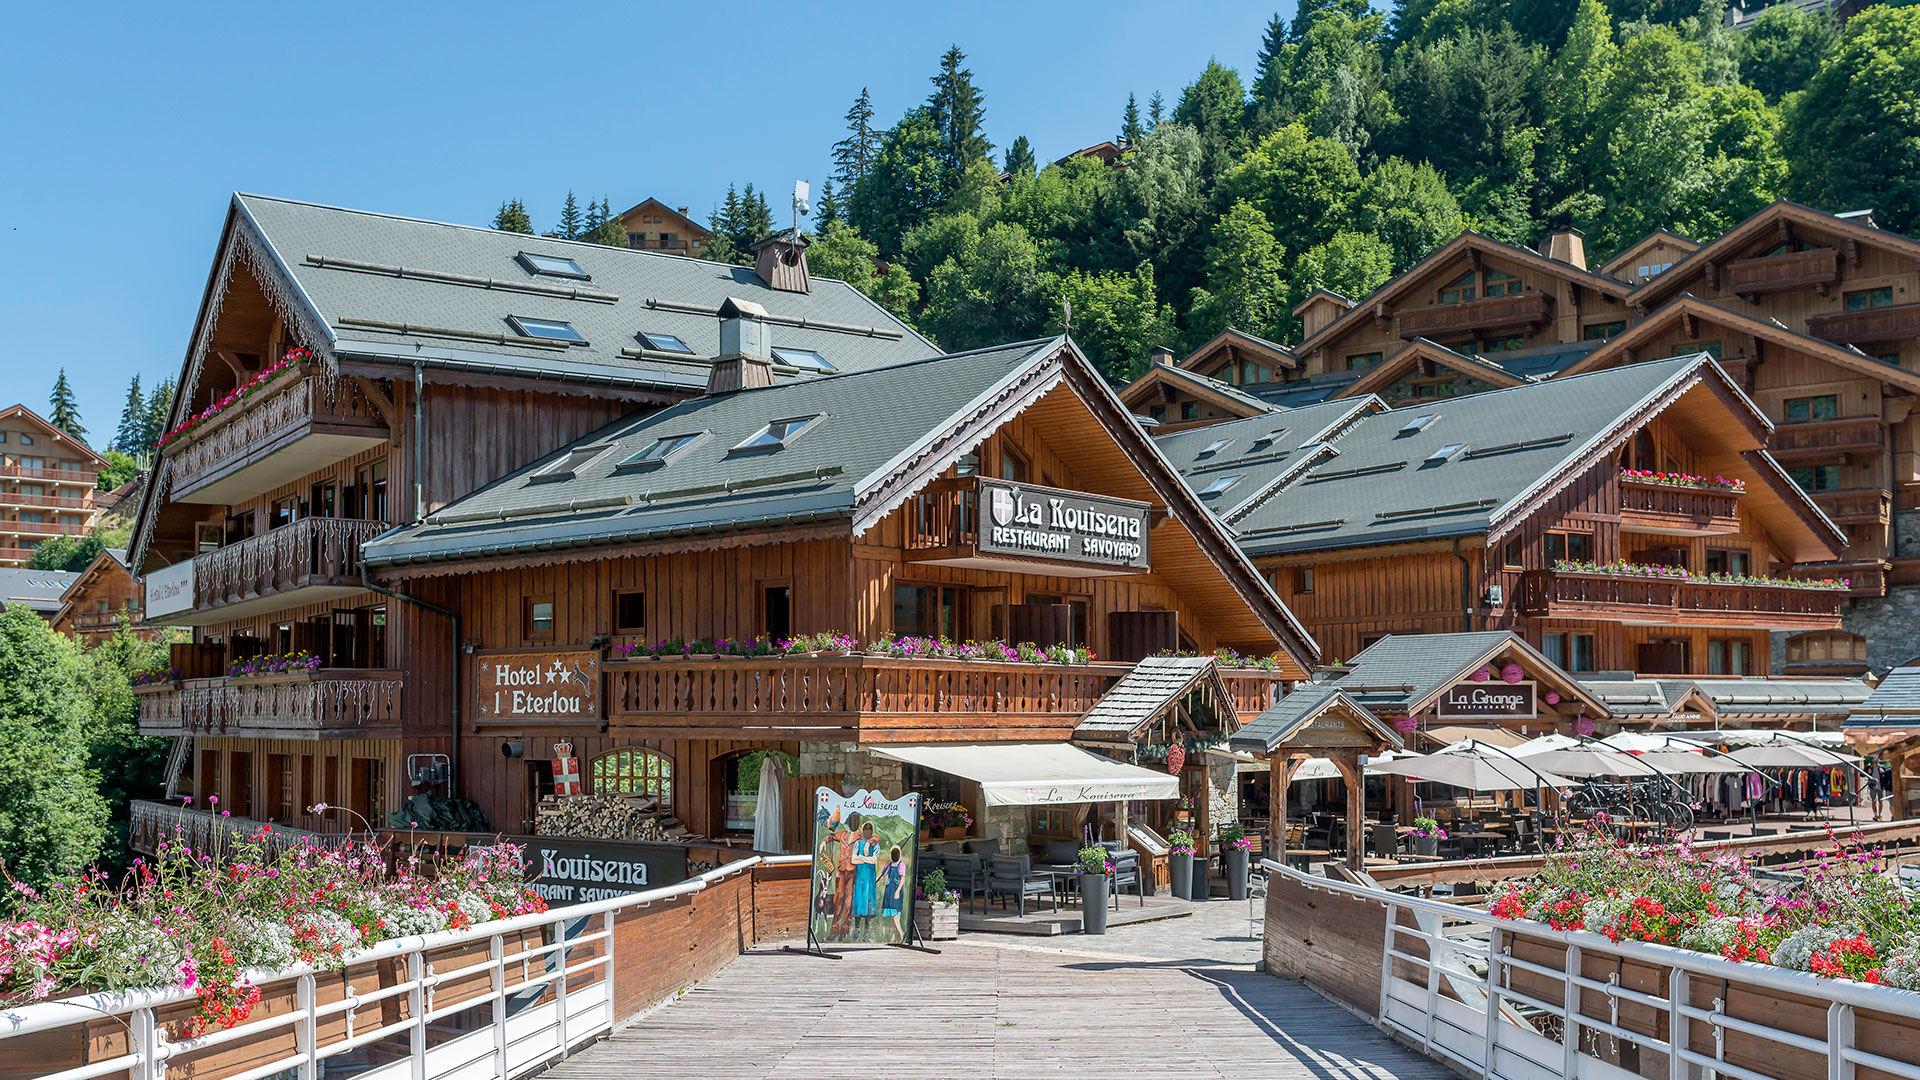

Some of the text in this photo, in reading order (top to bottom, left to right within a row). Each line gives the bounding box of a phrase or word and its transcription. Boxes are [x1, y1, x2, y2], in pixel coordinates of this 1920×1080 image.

[1014, 493, 1141, 538] La Kouisena
[992, 526, 1141, 558] RESTAURANT SAVOYARD
[495, 663, 541, 686] Hotel
[1449, 688, 1525, 710] La Grange
[1038, 787, 1064, 802] La
[540, 849, 648, 885] Kouisena
